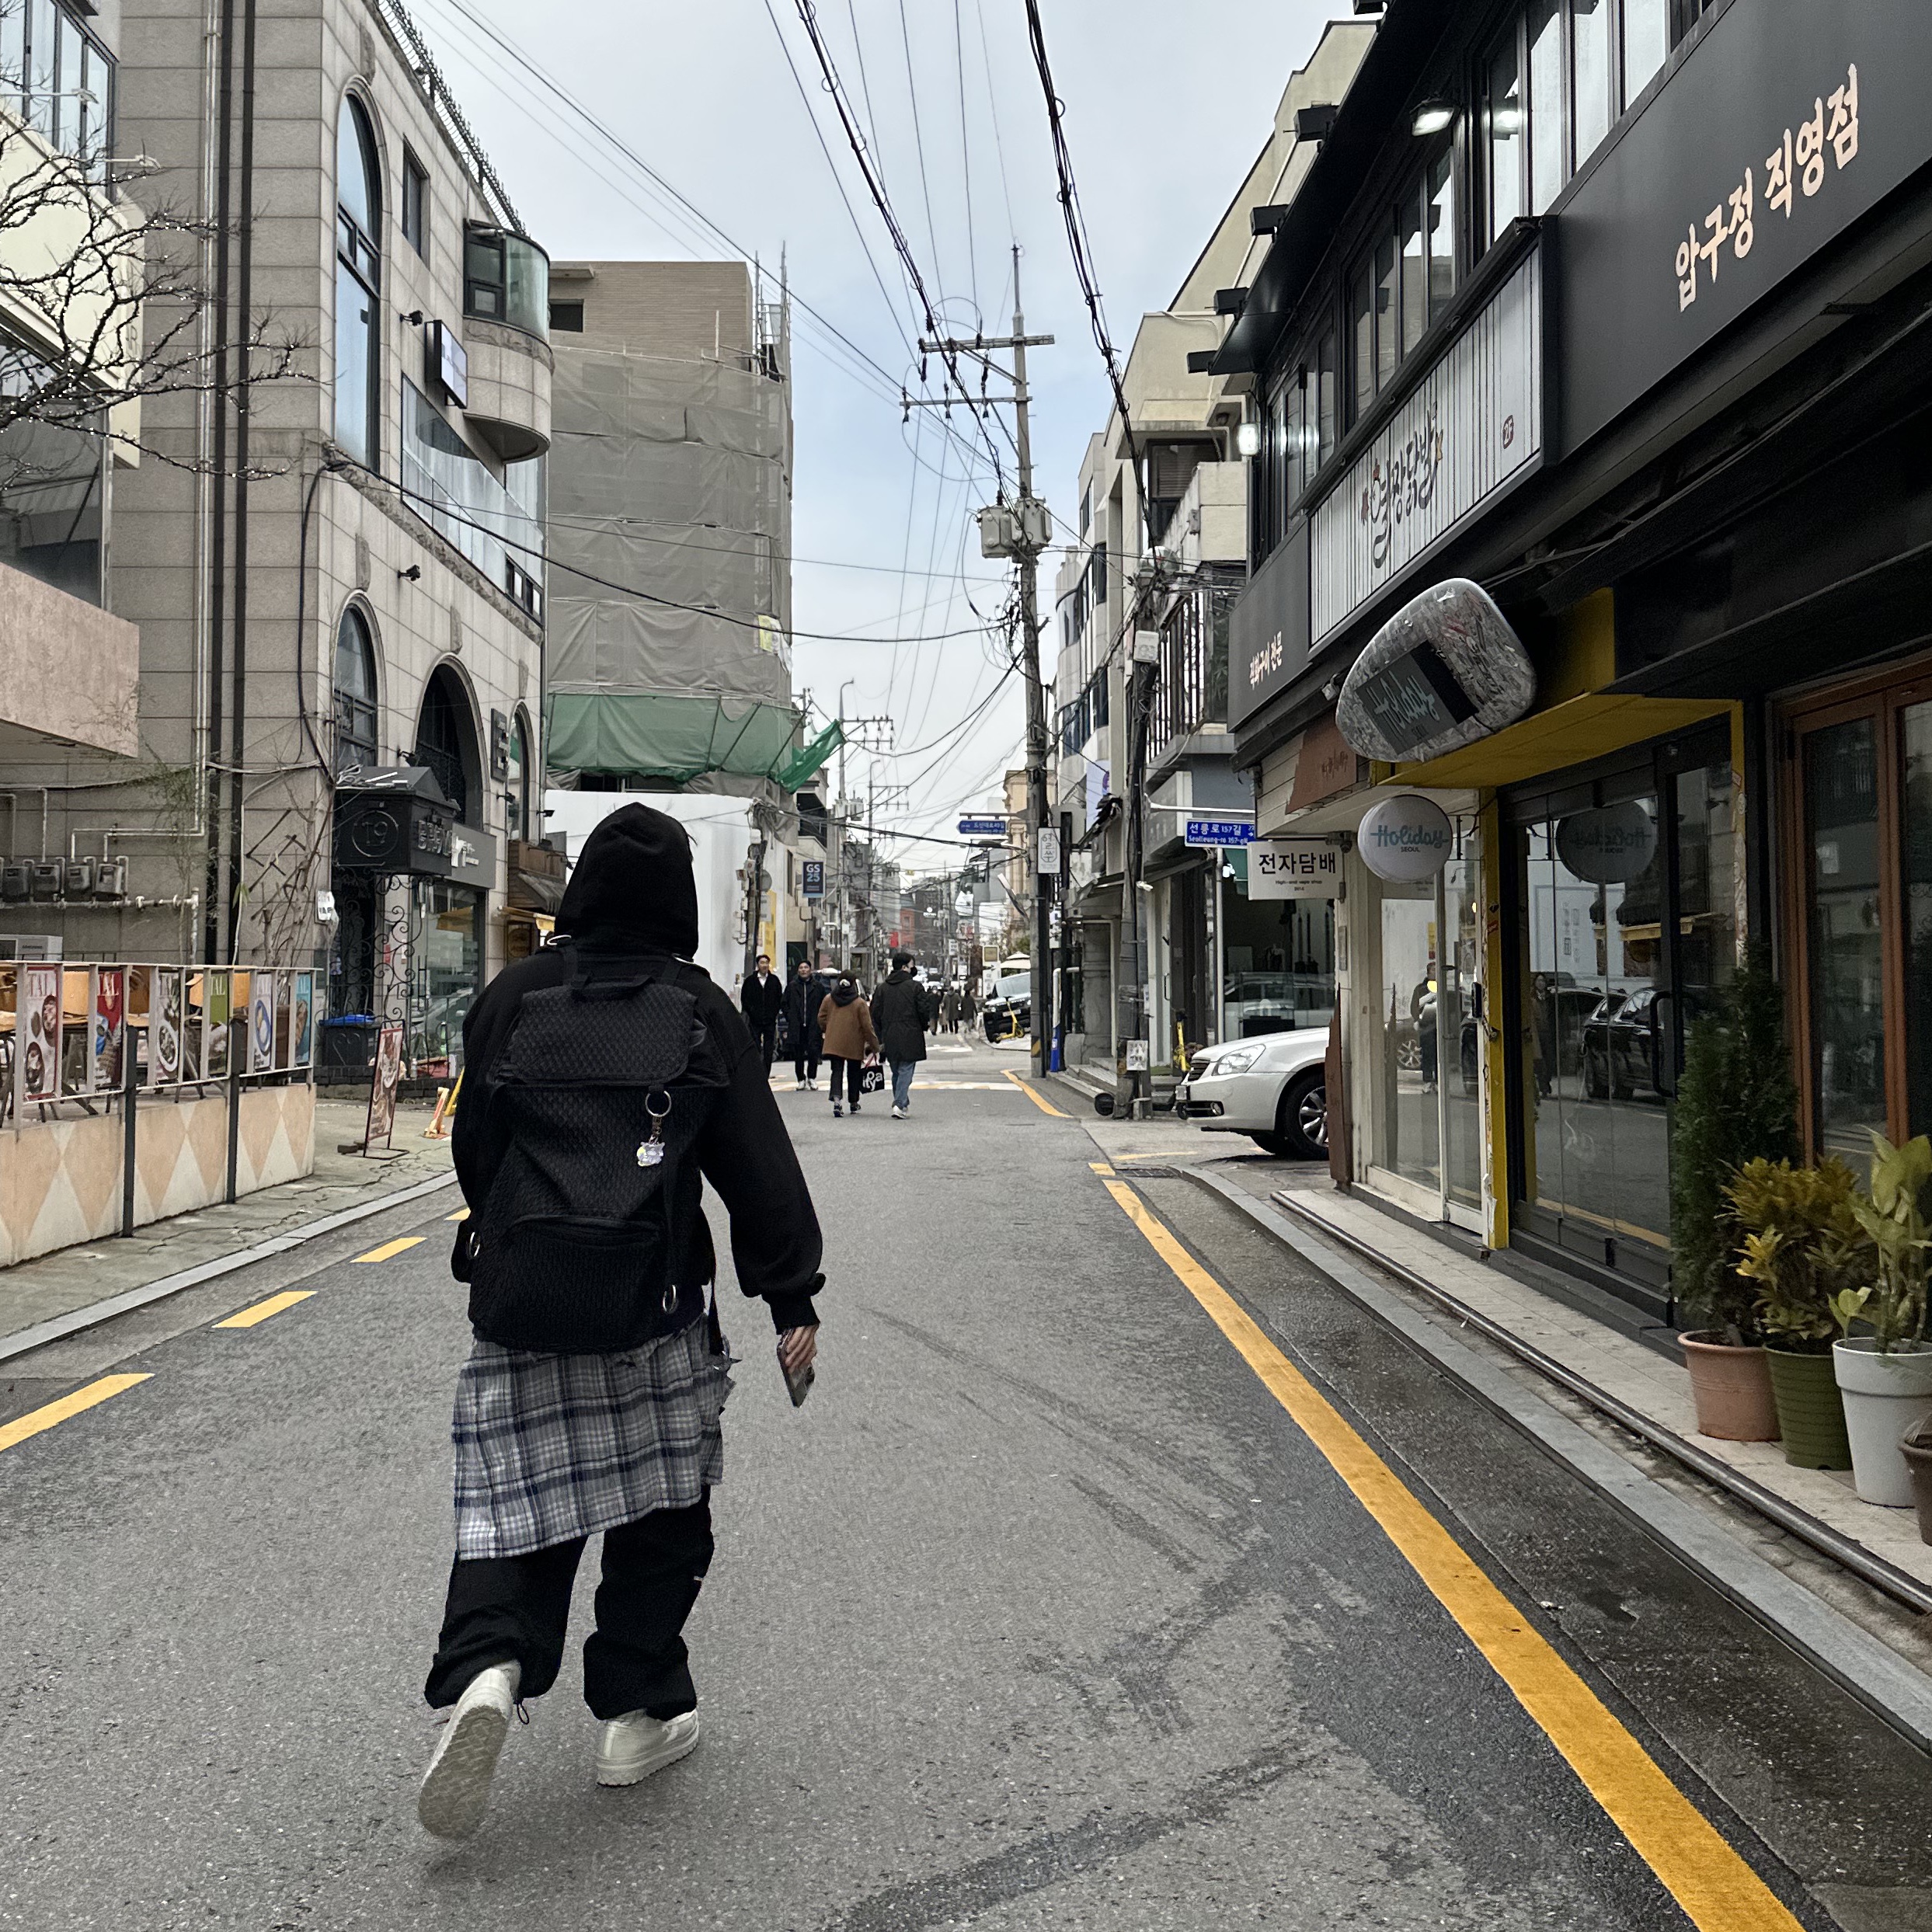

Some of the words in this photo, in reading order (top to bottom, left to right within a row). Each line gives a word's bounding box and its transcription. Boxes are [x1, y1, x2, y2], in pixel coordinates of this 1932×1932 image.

[1675, 167, 1753, 312] 압구정
[1764, 63, 1859, 218] 직영점
[1271, 631, 1283, 671] 전문
[1366, 670, 1440, 736] Holiday
[1370, 824, 1448, 849] Holiday
[806, 863, 820, 873] GS
[1258, 851, 1336, 875] 전자담배
[806, 873, 820, 882] 25
